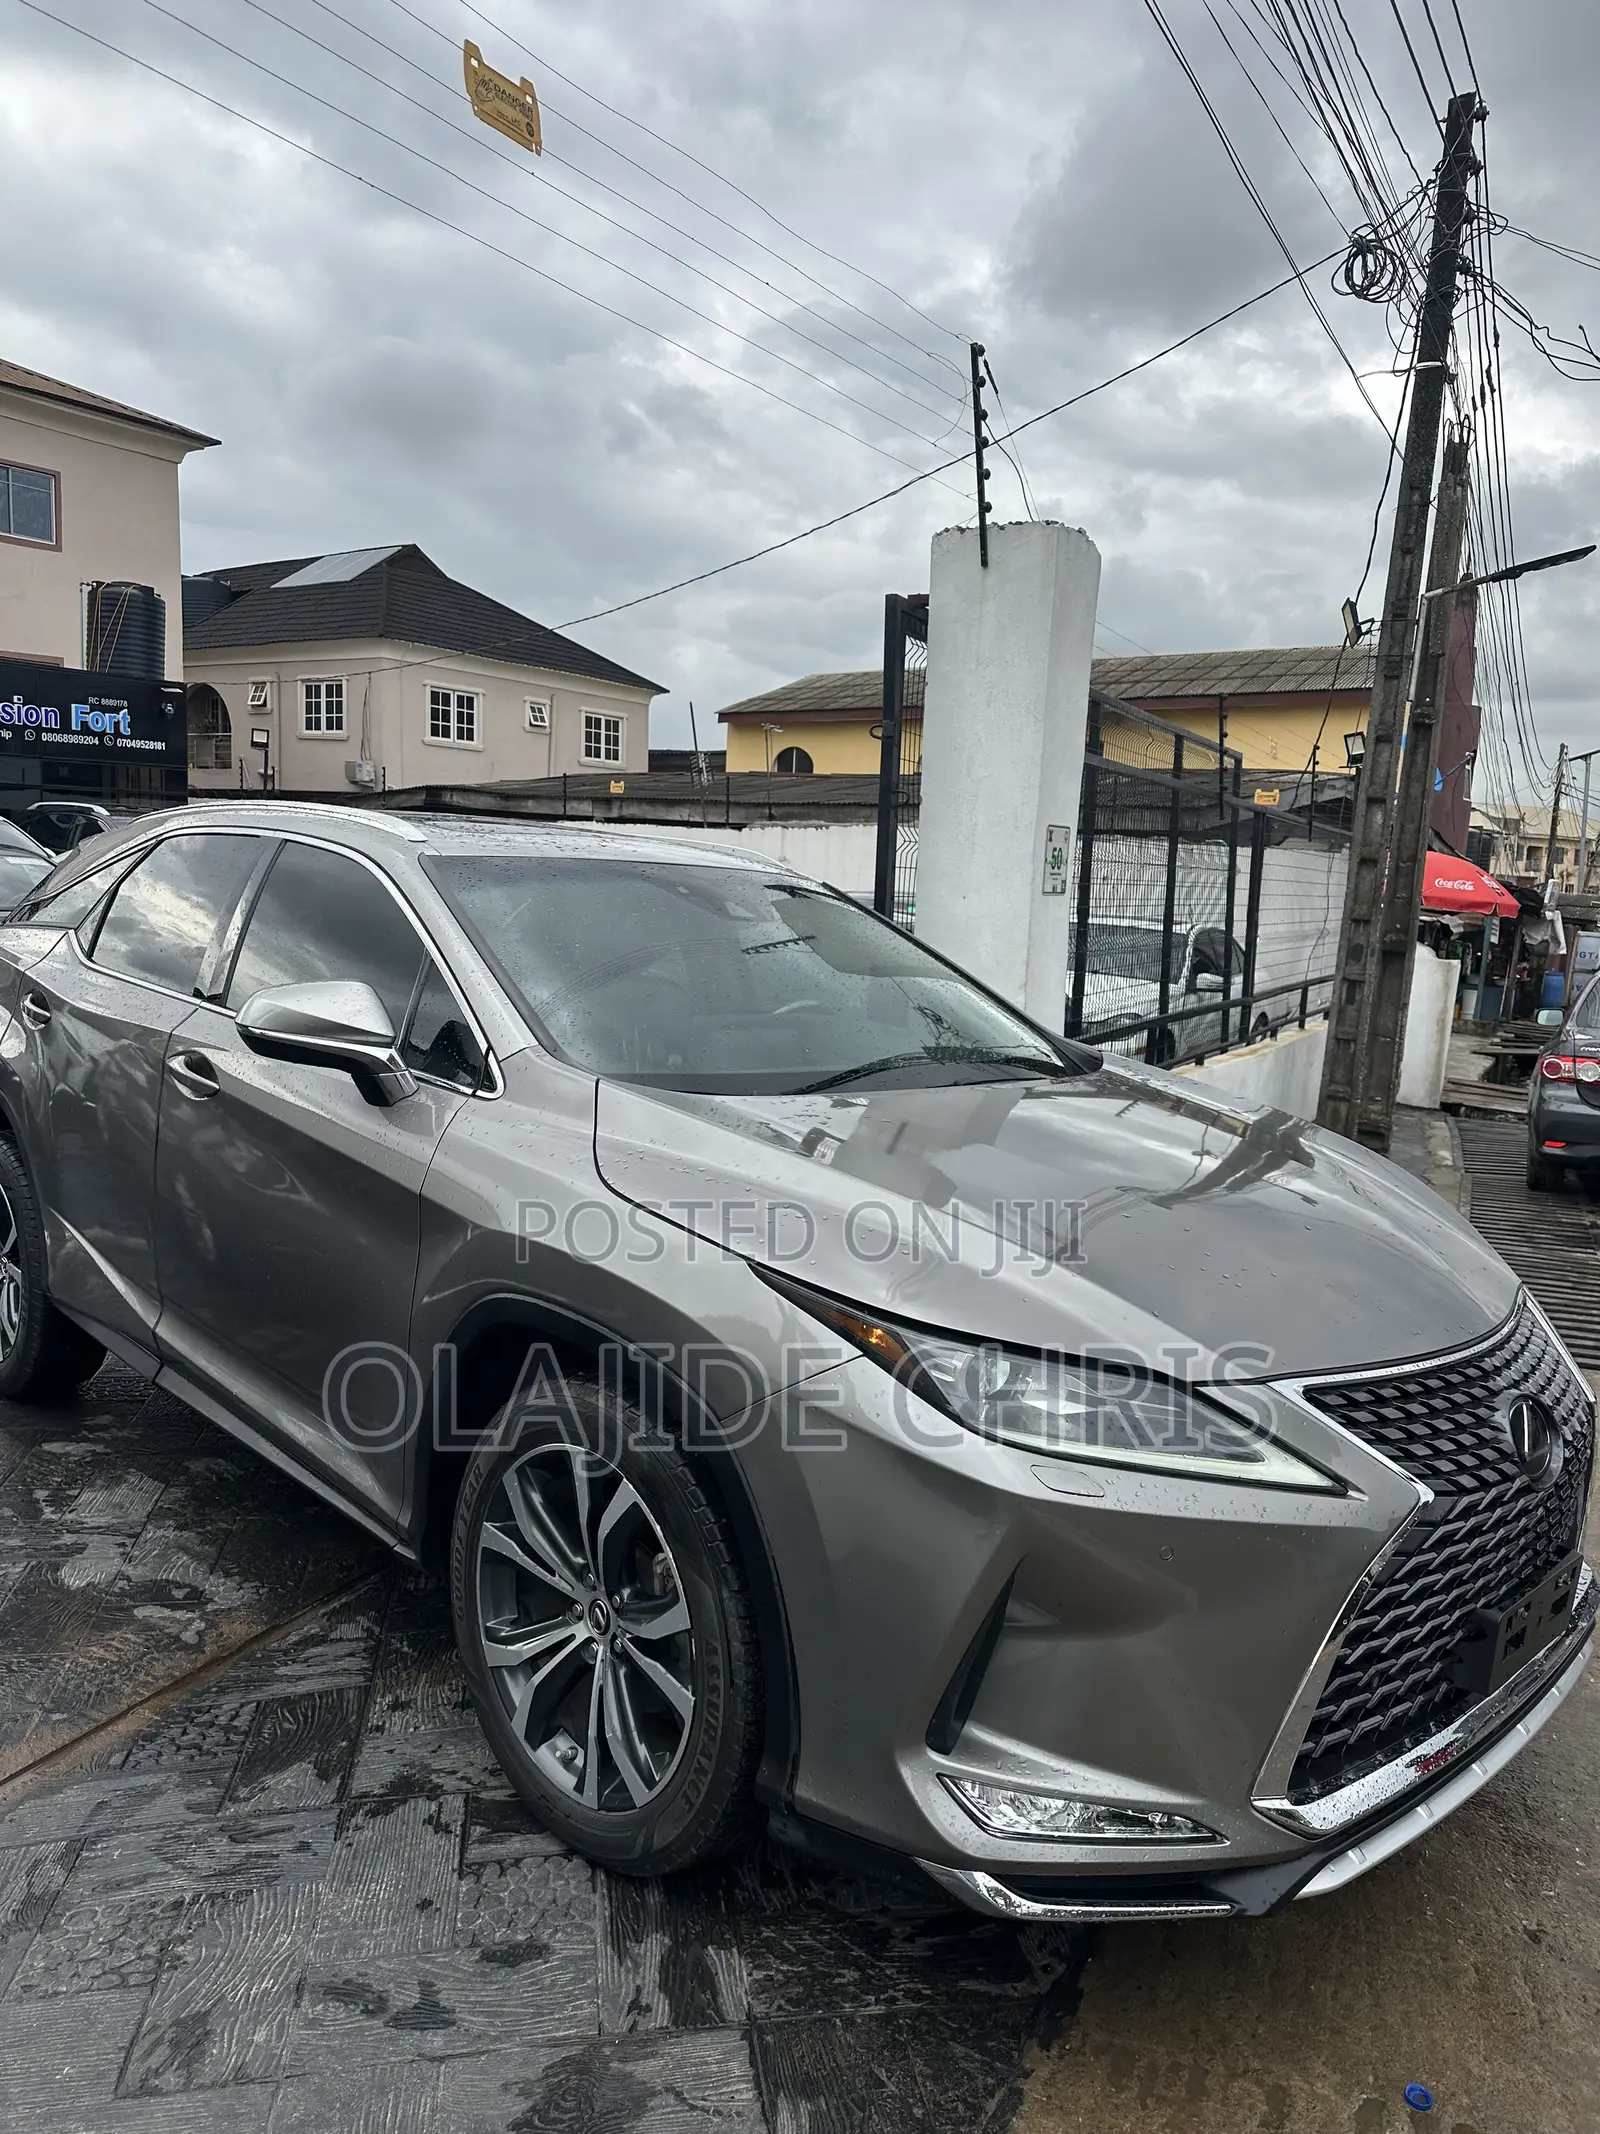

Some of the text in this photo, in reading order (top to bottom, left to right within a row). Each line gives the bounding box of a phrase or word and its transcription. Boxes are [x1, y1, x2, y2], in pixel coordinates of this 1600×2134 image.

[494, 83, 534, 115] DANGER
[88, 697, 99, 705] RC
[0, 695, 131, 735] sion Fort
[116, 738, 166, 750] 07049528181
[1051, 847, 1062, 870] 50
